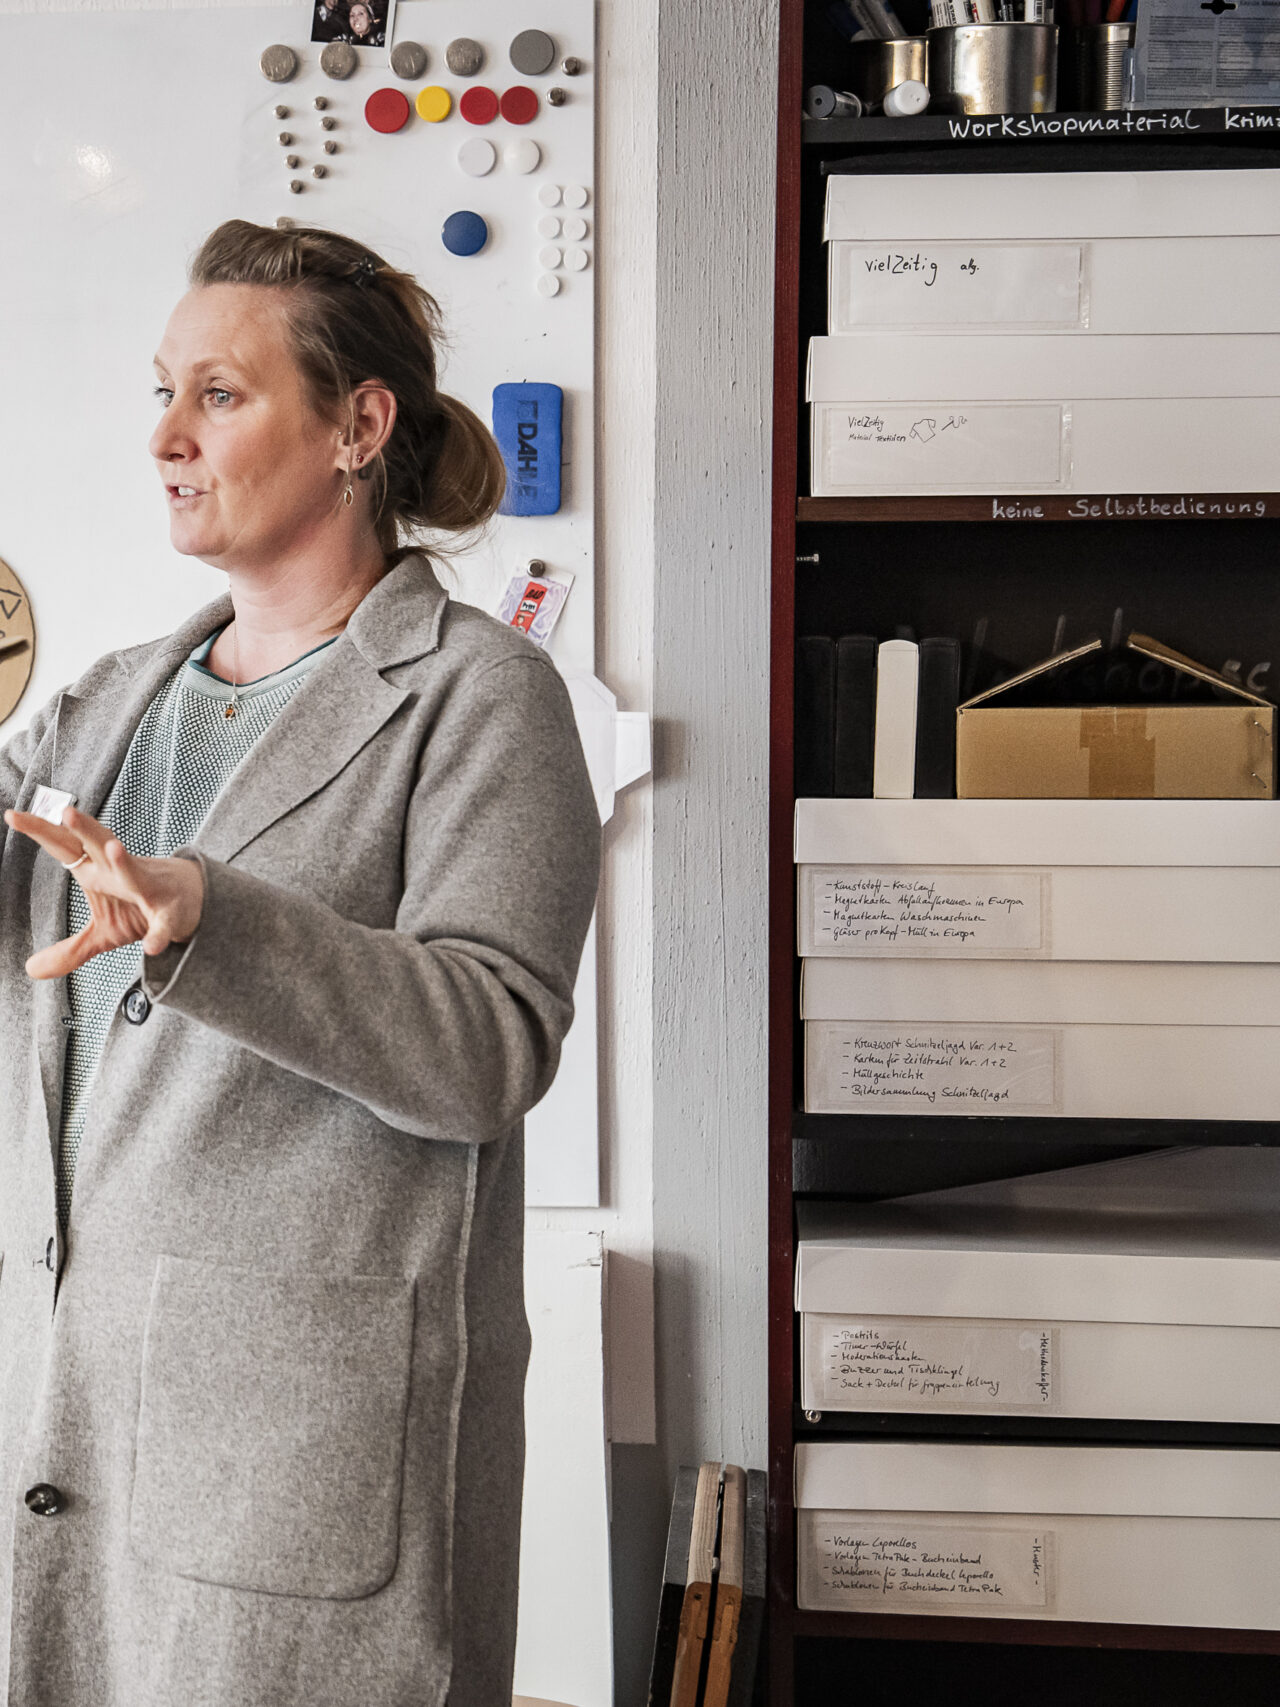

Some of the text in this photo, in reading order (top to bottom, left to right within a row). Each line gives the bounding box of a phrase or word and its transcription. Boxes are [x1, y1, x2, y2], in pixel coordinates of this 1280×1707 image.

[949, 109, 1201, 138] Workshopmaterial
[992, 497, 1267, 519] keine Selbstbedienung
[976, 896, 984, 906] in
[988, 896, 1025, 914] Europa
[900, 911, 987, 922] Waschmaschinen
[833, 926, 861, 941] Gläser
[944, 928, 975, 942] Europa
[854, 1037, 901, 1050] Kreuzwort
[905, 1037, 966, 1055] Schnitzeljagd
[854, 1053, 884, 1065] Karten
[886, 1052, 900, 1069] für
[853, 1068, 924, 1085] Müllgeschichte
[851, 1084, 1009, 1103] Bildersammlung Schnitzeljagd
[840, 1364, 881, 1374] Buzzer
[883, 1367, 904, 1375] und
[840, 1378, 864, 1389] Sack
